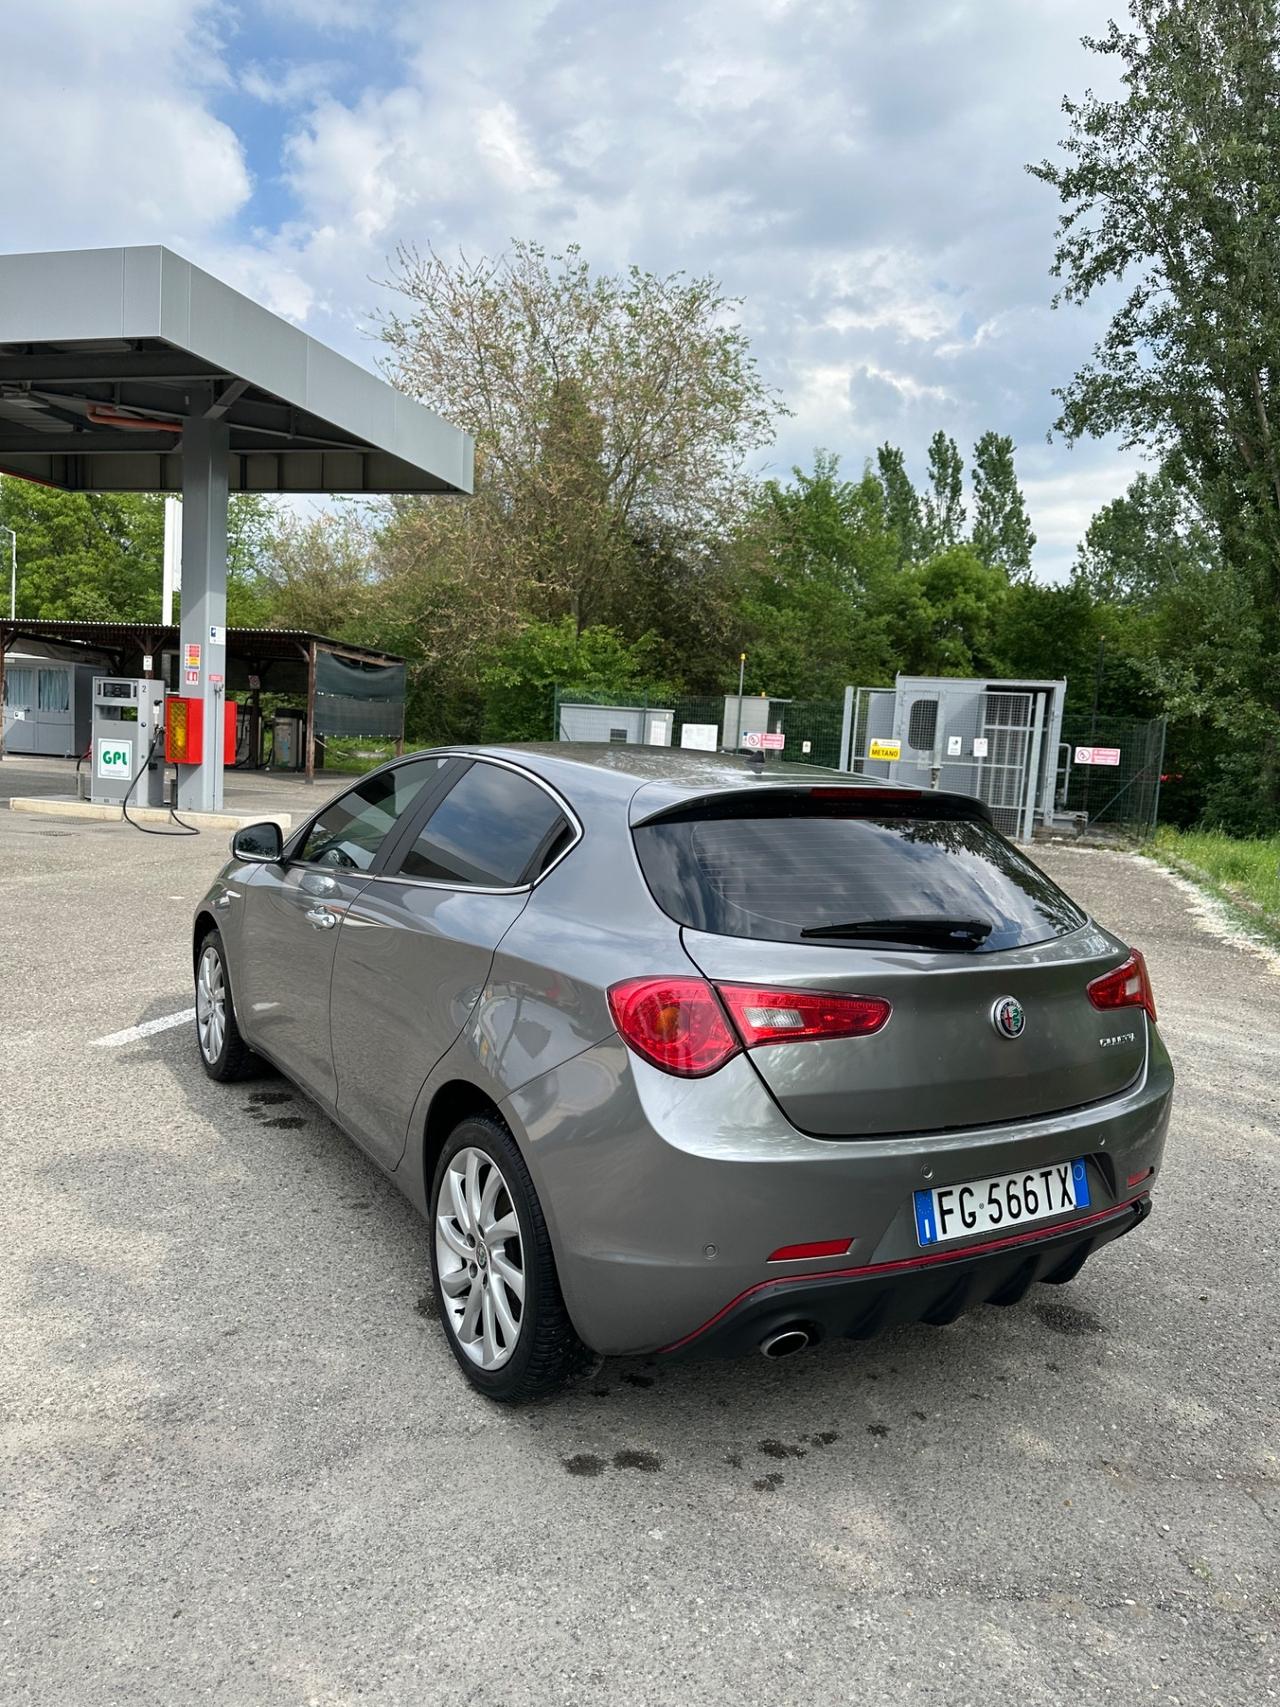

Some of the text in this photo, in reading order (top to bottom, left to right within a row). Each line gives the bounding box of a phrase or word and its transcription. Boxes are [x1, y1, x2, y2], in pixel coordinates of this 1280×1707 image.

[142, 685, 147, 693] 2
[103, 750, 127, 765] GPL
[871, 748, 899, 758] METANO
[937, 1165, 1074, 1235] FG 566TX
